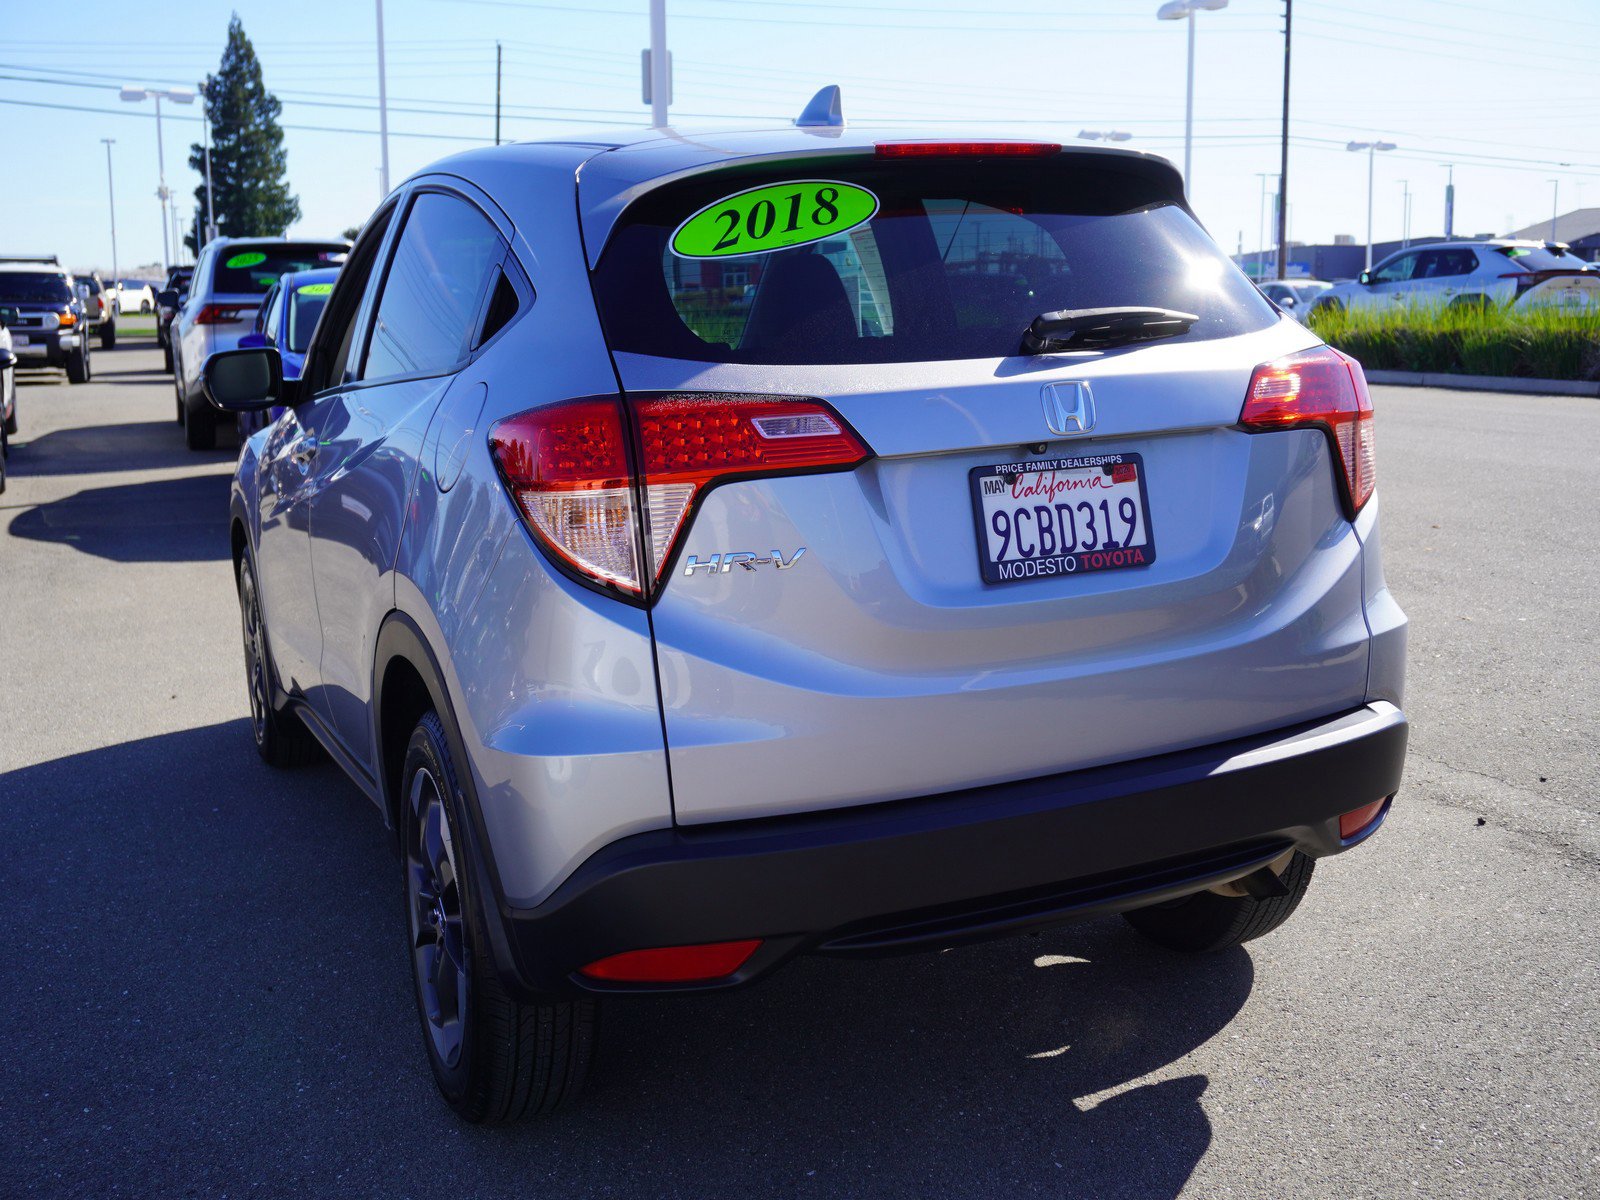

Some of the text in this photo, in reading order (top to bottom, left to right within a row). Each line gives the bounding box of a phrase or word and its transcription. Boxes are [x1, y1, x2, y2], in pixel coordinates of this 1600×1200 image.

[712, 187, 839, 251] 2018
[995, 455, 1123, 474] PRICE FAMILY DEALERSHIPS
[984, 479, 1005, 495] MAY
[1011, 470, 1113, 503] California
[992, 497, 1137, 561] 9CBD319
[684, 548, 806, 576] HR-V
[998, 548, 1145, 579] MODESTO TOYOTA
